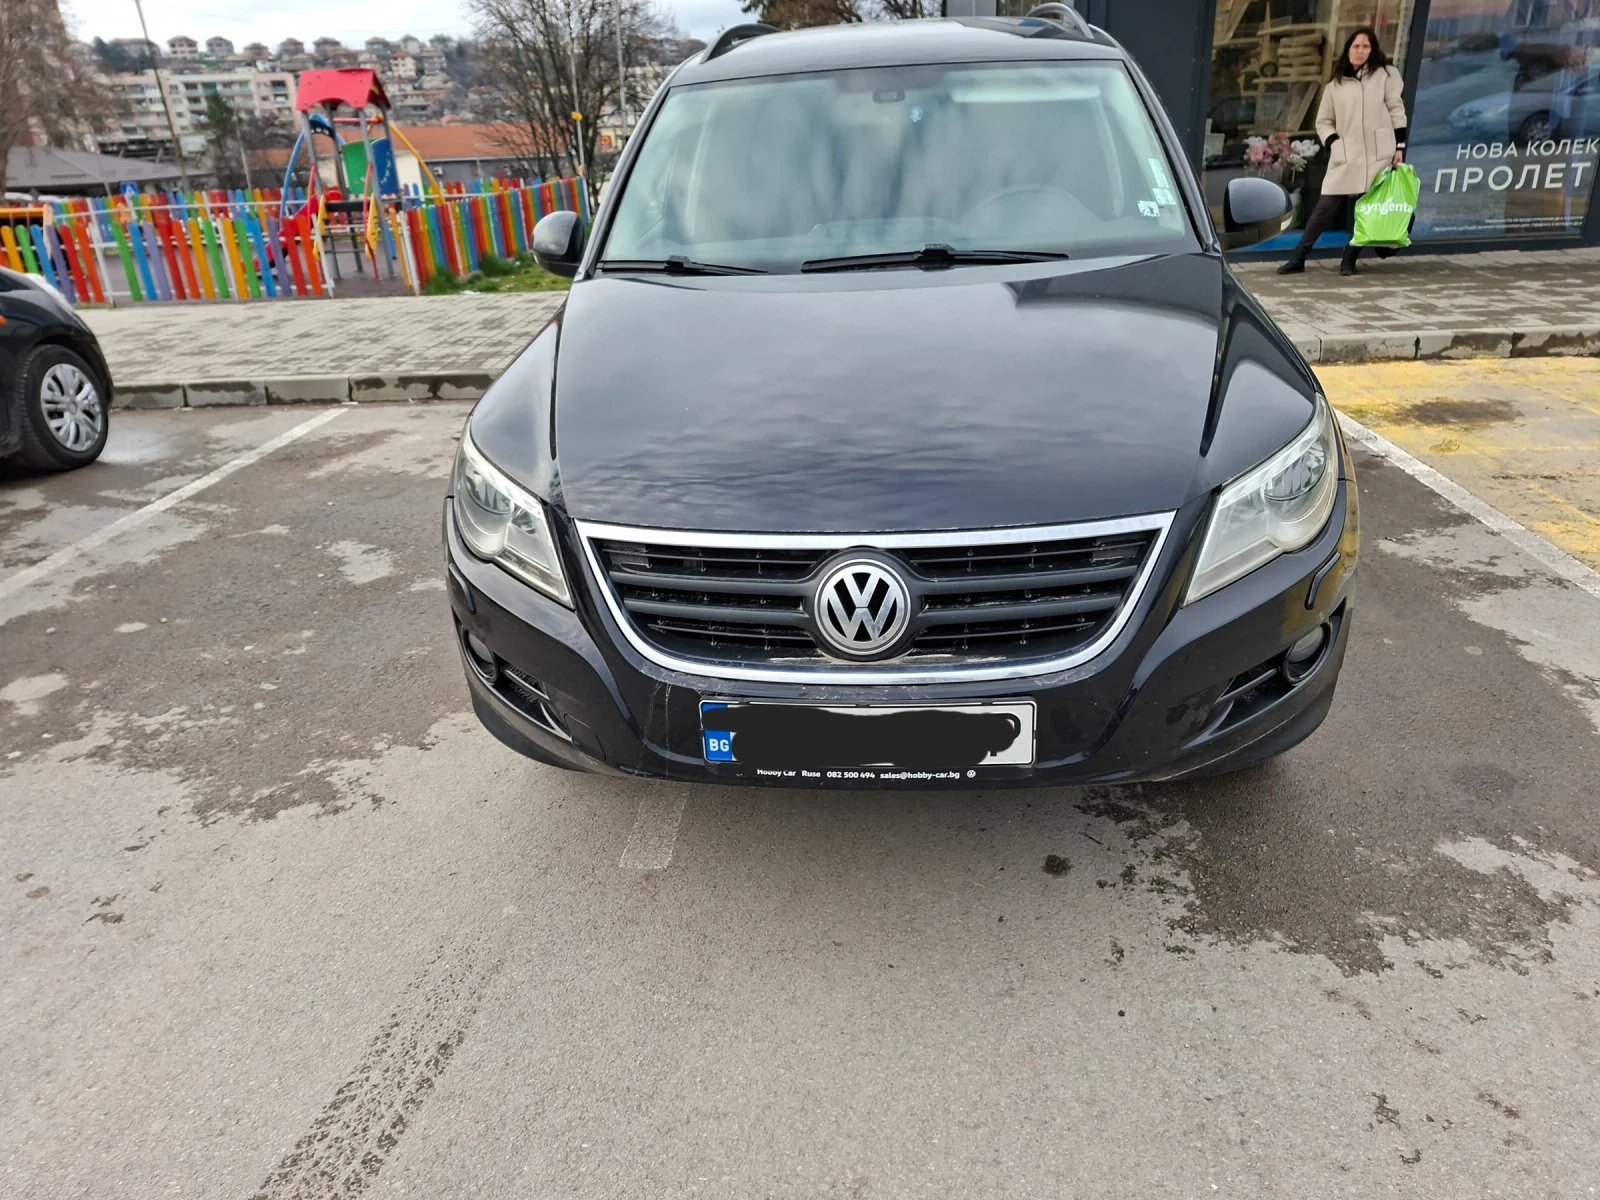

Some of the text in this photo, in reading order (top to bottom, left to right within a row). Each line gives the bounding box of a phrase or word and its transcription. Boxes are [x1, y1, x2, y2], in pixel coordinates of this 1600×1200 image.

[1456, 138, 1600, 160] НОВА КОЛЕК
[1434, 162, 1591, 193] ПРОЛЕТ
[1360, 200, 1414, 215] syngenta
[709, 738, 730, 752] BG
[801, 769, 821, 778] Ruse
[843, 771, 859, 779] 500
[860, 771, 875, 779] 494
[880, 771, 960, 780] sales@hobby-car.bg
